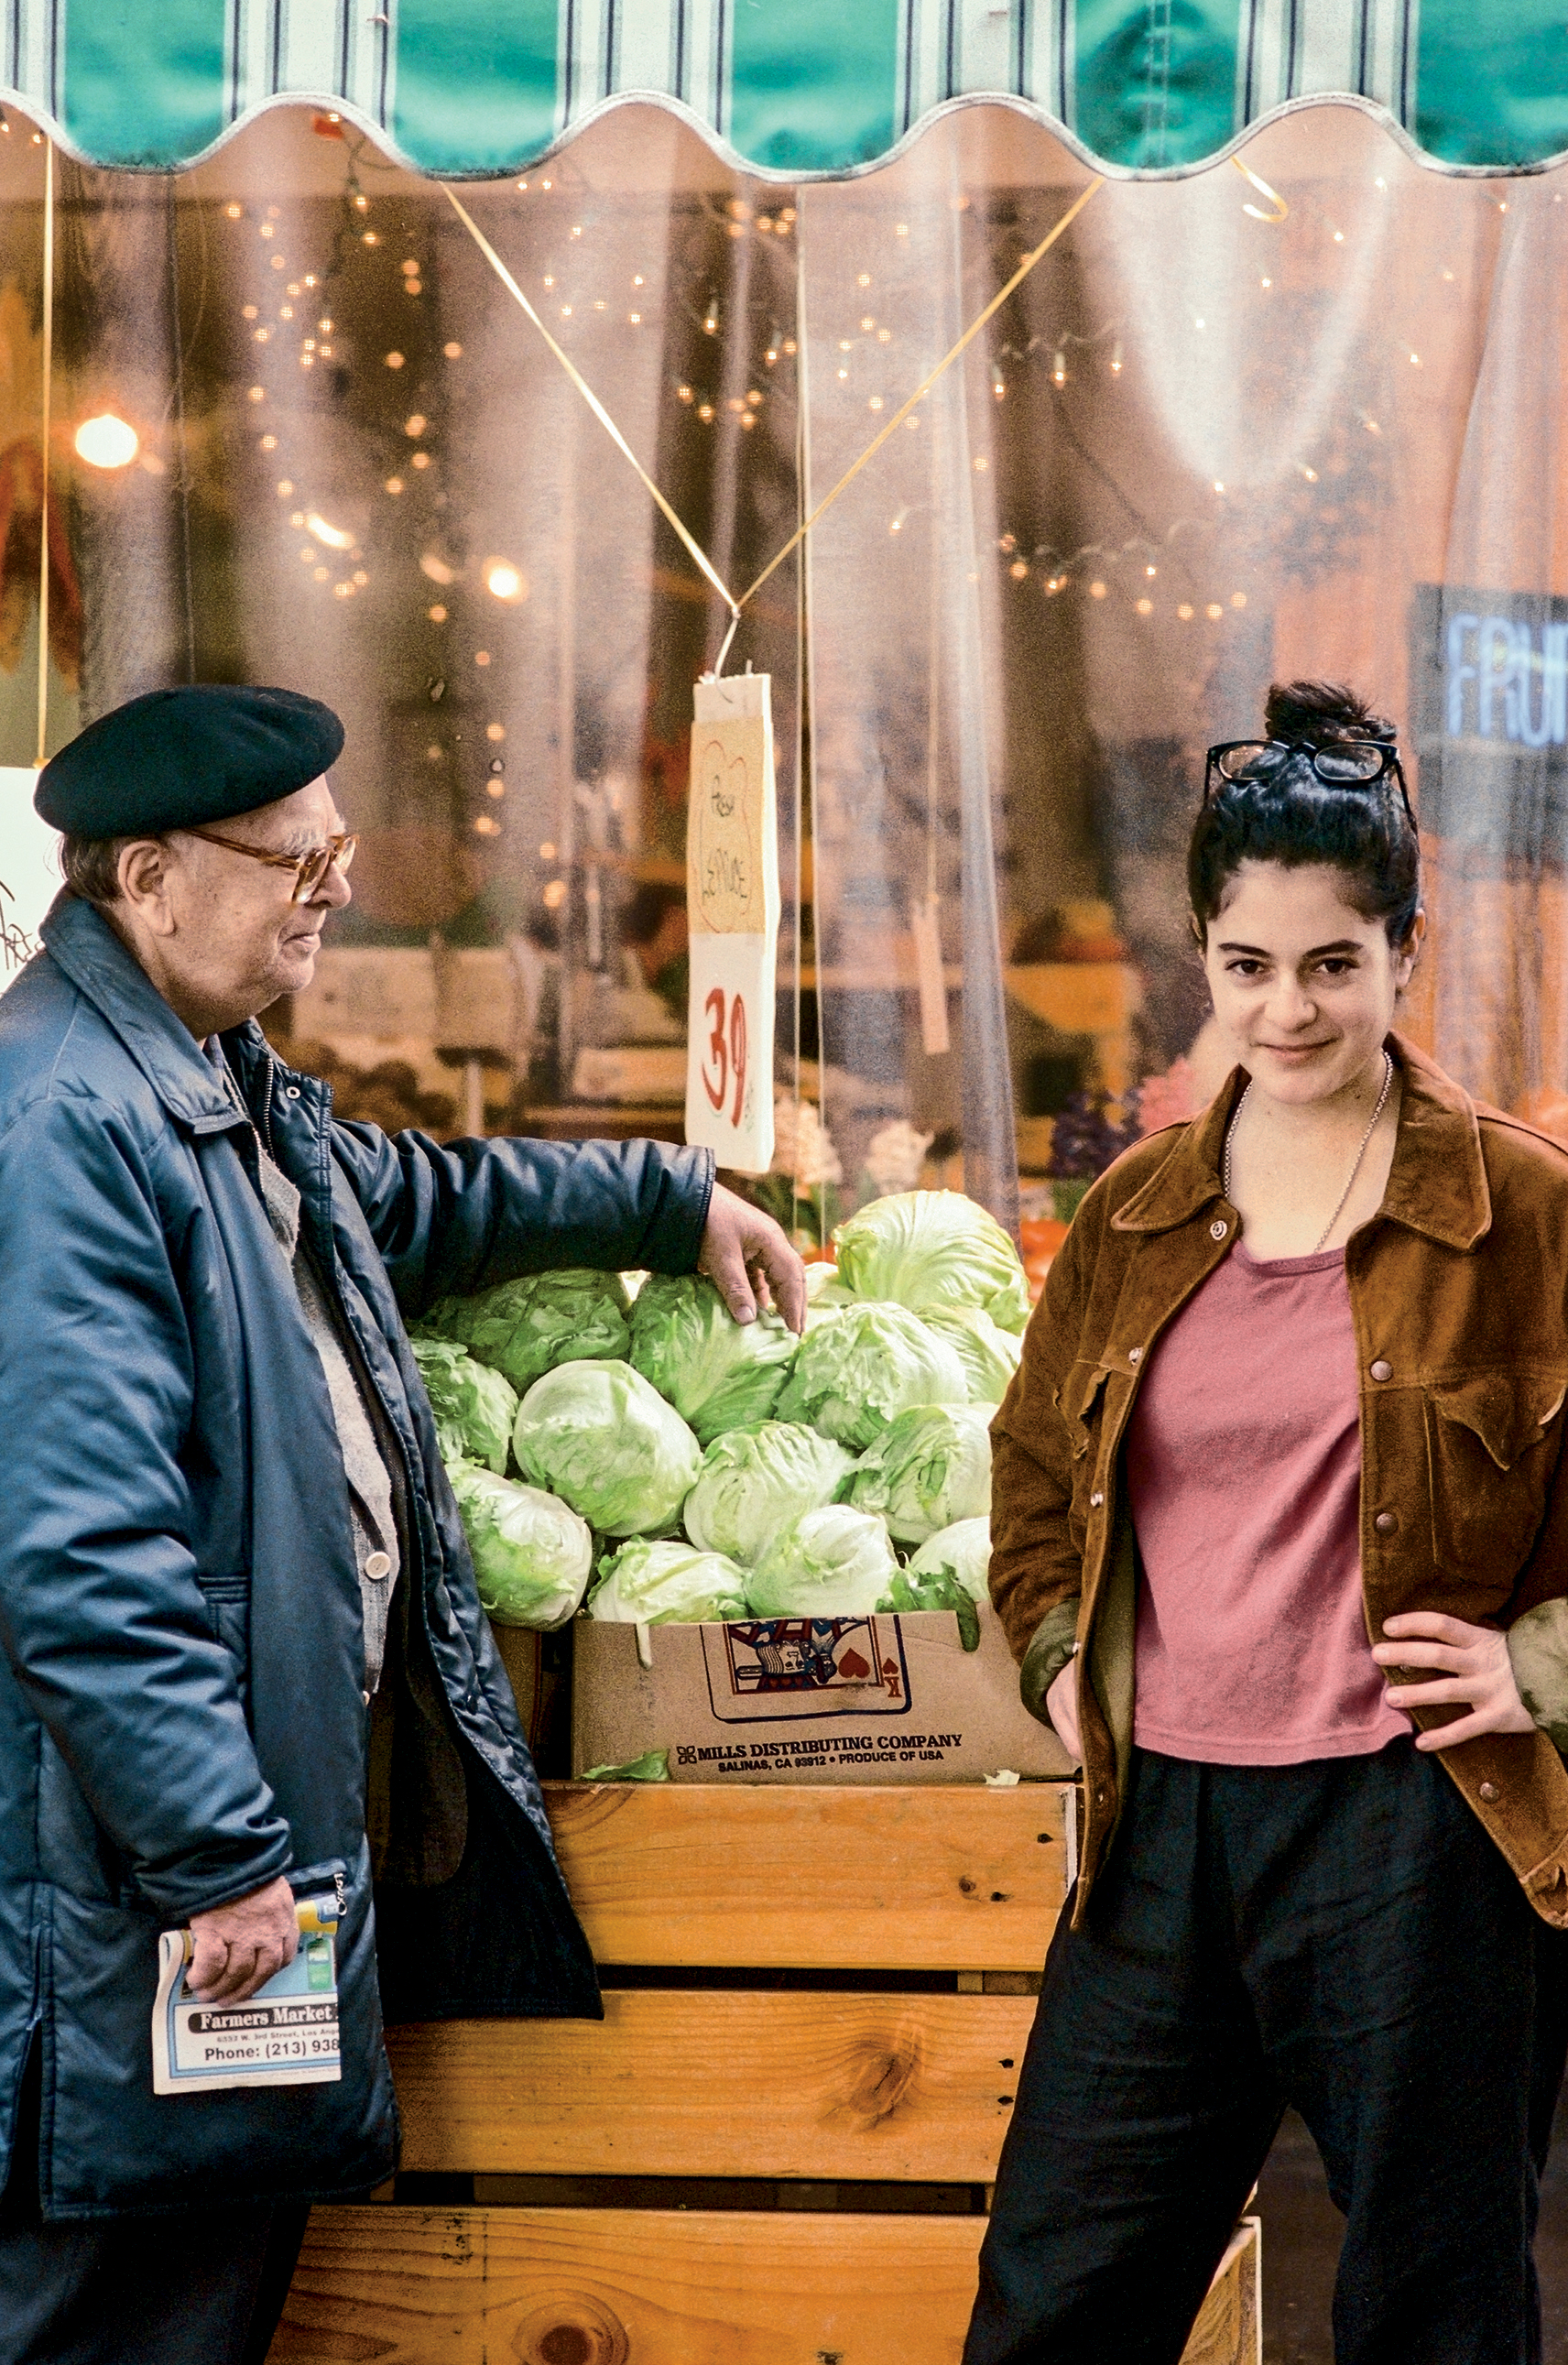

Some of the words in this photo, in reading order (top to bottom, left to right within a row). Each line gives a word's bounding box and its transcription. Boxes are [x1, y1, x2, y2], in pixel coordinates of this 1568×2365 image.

[1448, 612, 1568, 747] FRUI
[702, 987, 746, 1128] 39
[697, 1745, 746, 1760] MILLS
[749, 1736, 873, 1757] DISTRIBUTING
[877, 1734, 963, 1749] COMPANY
[718, 1760, 772, 1772] SALINAS,
[775, 1758, 792, 1769] CA
[795, 1755, 826, 1767] 93912
[839, 1751, 897, 1764] PRODUCE
[899, 1750, 916, 1761] OF
[919, 1749, 944, 1760] USA
[200, 2012, 269, 2030] Farmers
[273, 2005, 332, 2022] Market
[204, 2047, 260, 2061] Phone:
[266, 2041, 306, 2058] (213)
[311, 2038, 340, 2053] 938
